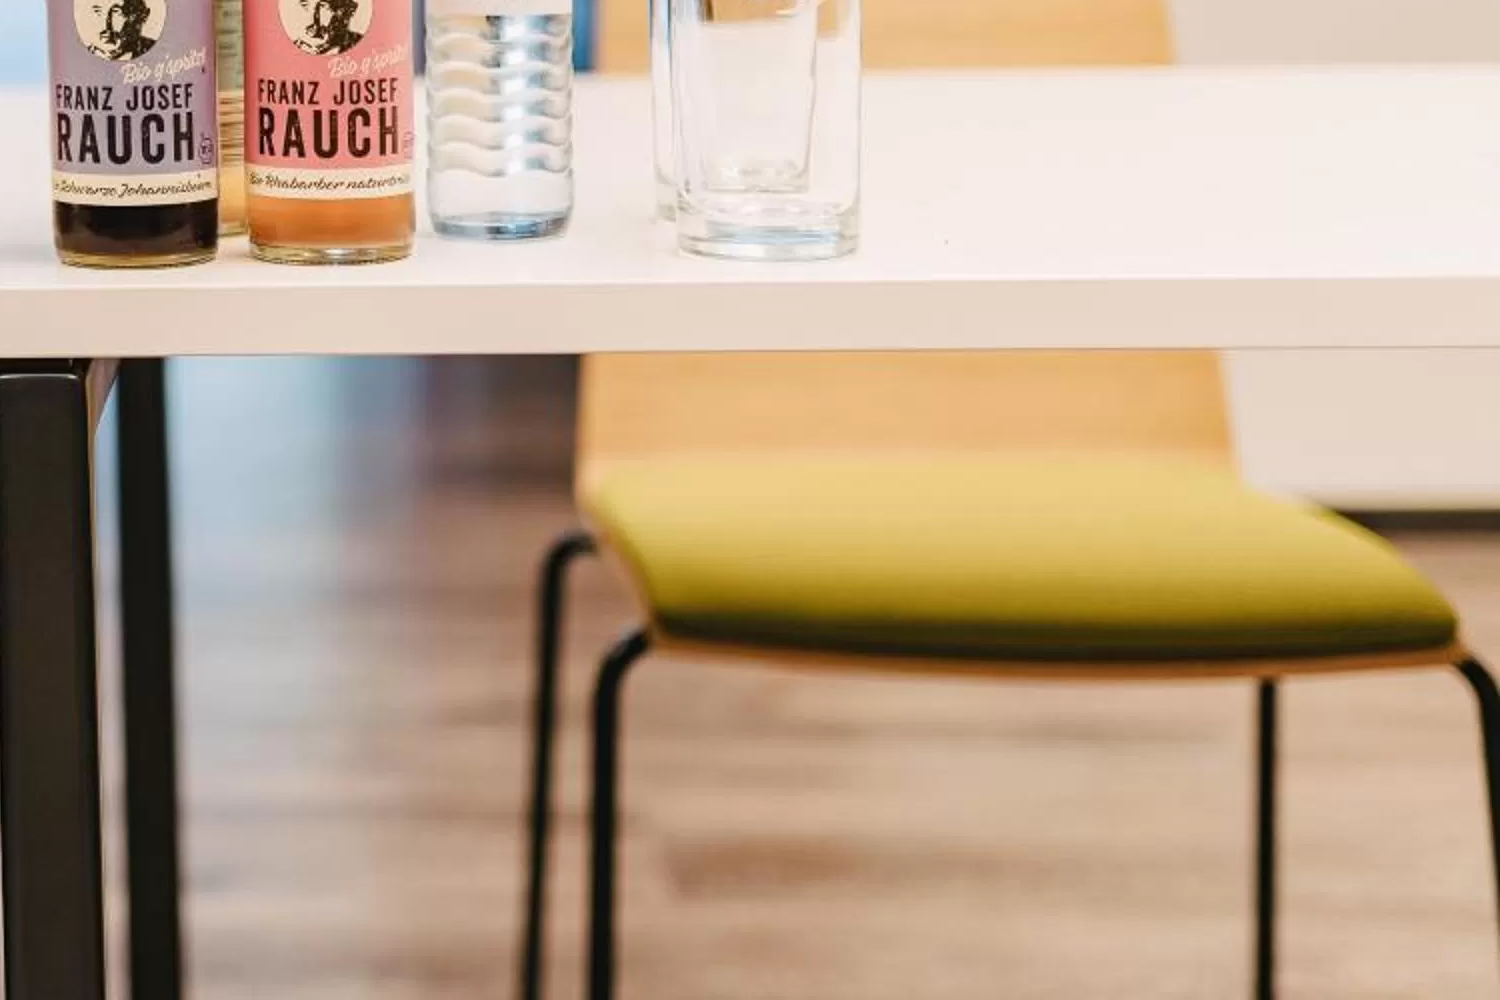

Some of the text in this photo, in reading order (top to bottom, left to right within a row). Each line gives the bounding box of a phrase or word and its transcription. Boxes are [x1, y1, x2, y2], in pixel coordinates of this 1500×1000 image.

[56, 83, 194, 111] FRANZ JOSEF
[259, 78, 399, 105] FRANZ JOSEF
[57, 111, 195, 165] RAUCH
[259, 106, 399, 159] RAUCH
